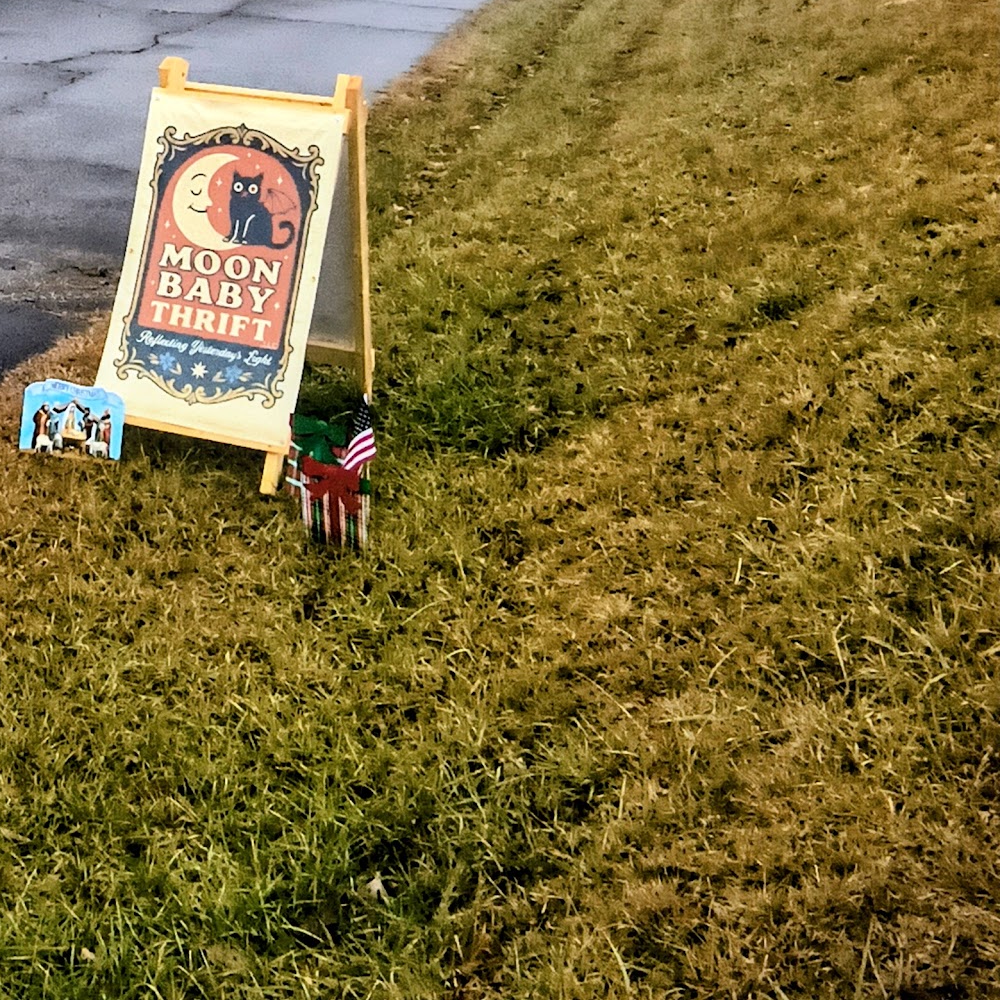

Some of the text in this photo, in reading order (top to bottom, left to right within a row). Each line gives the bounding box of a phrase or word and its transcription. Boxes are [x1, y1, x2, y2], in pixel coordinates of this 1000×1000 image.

[159, 243, 282, 285] MOON
[156, 271, 276, 314] BABY
[151, 301, 272, 342] THRIFT
[136, 330, 189, 352] Reflecting
[243, 349, 273, 366] Light
